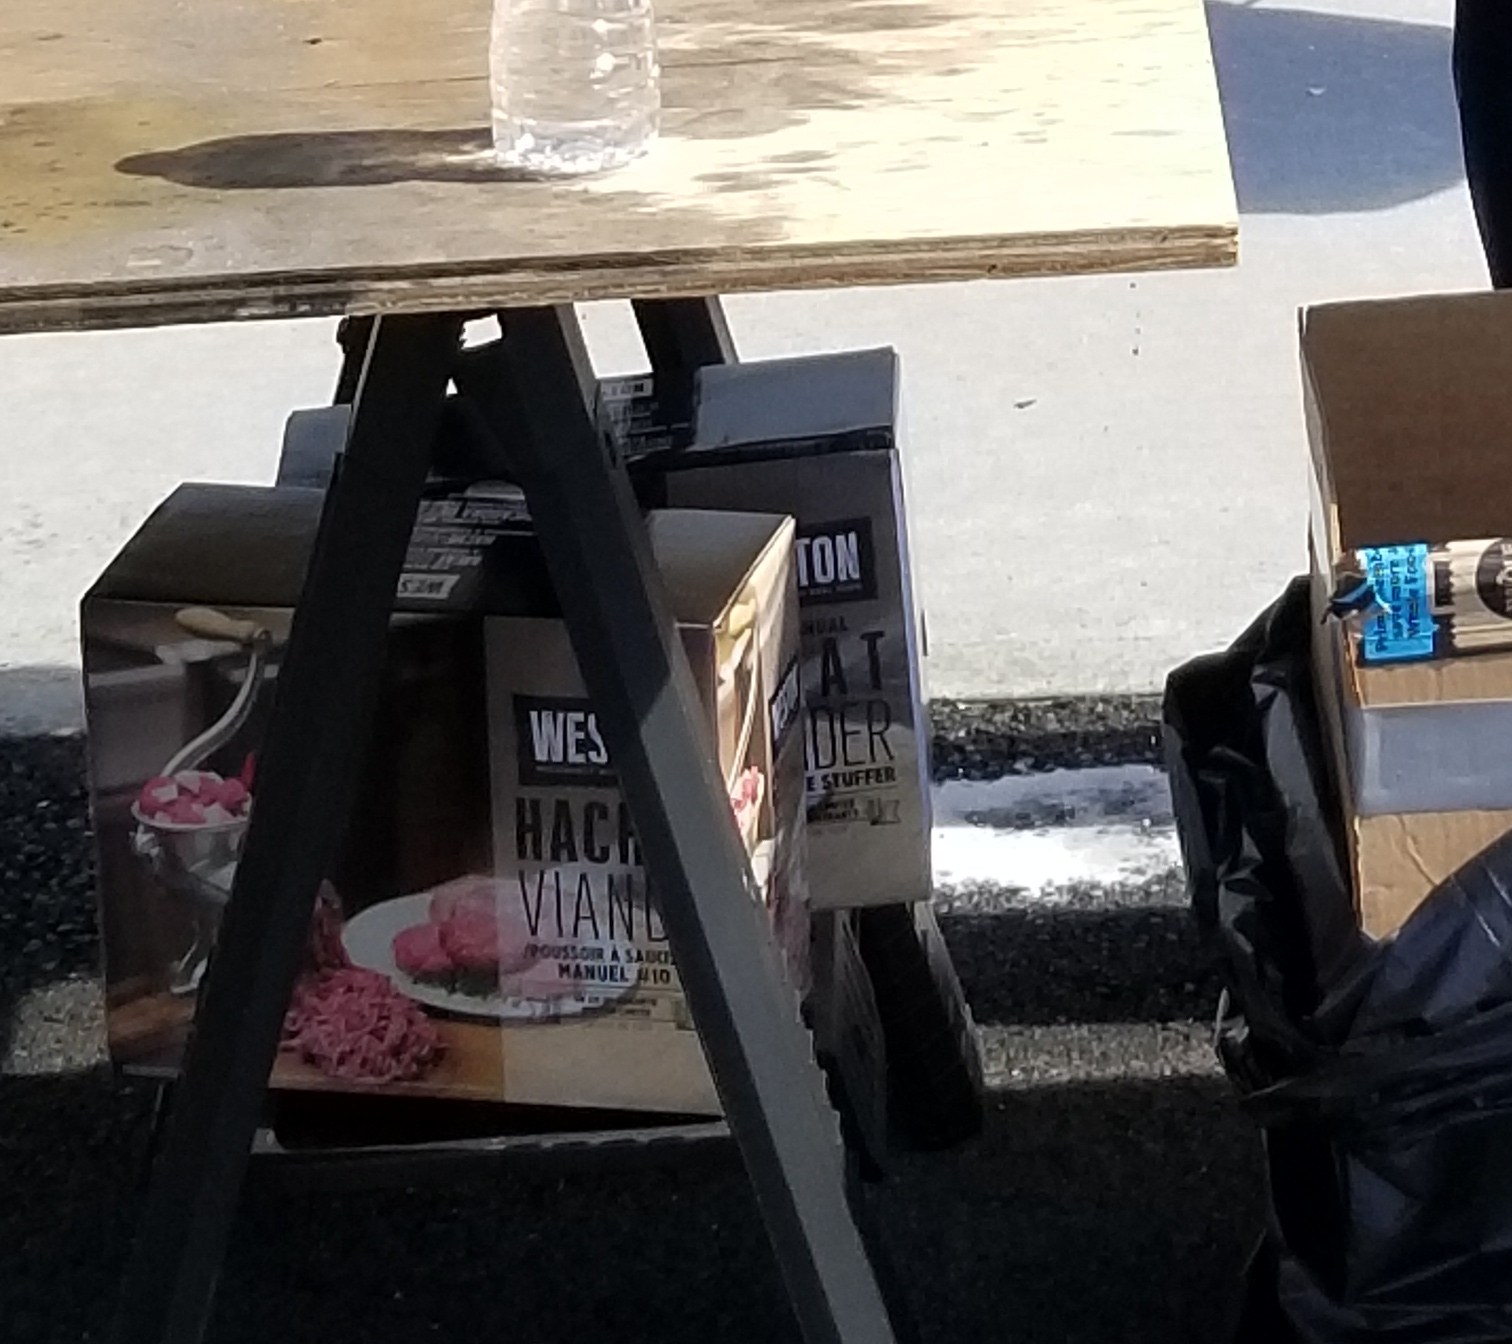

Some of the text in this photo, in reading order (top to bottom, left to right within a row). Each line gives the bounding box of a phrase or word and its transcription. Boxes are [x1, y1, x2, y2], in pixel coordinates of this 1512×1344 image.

[796, 531, 861, 588] TON
[819, 629, 886, 698] AT
[529, 710, 609, 765] WES
[821, 767, 897, 791] STUFFER
[557, 963, 630, 983] MANUEL
